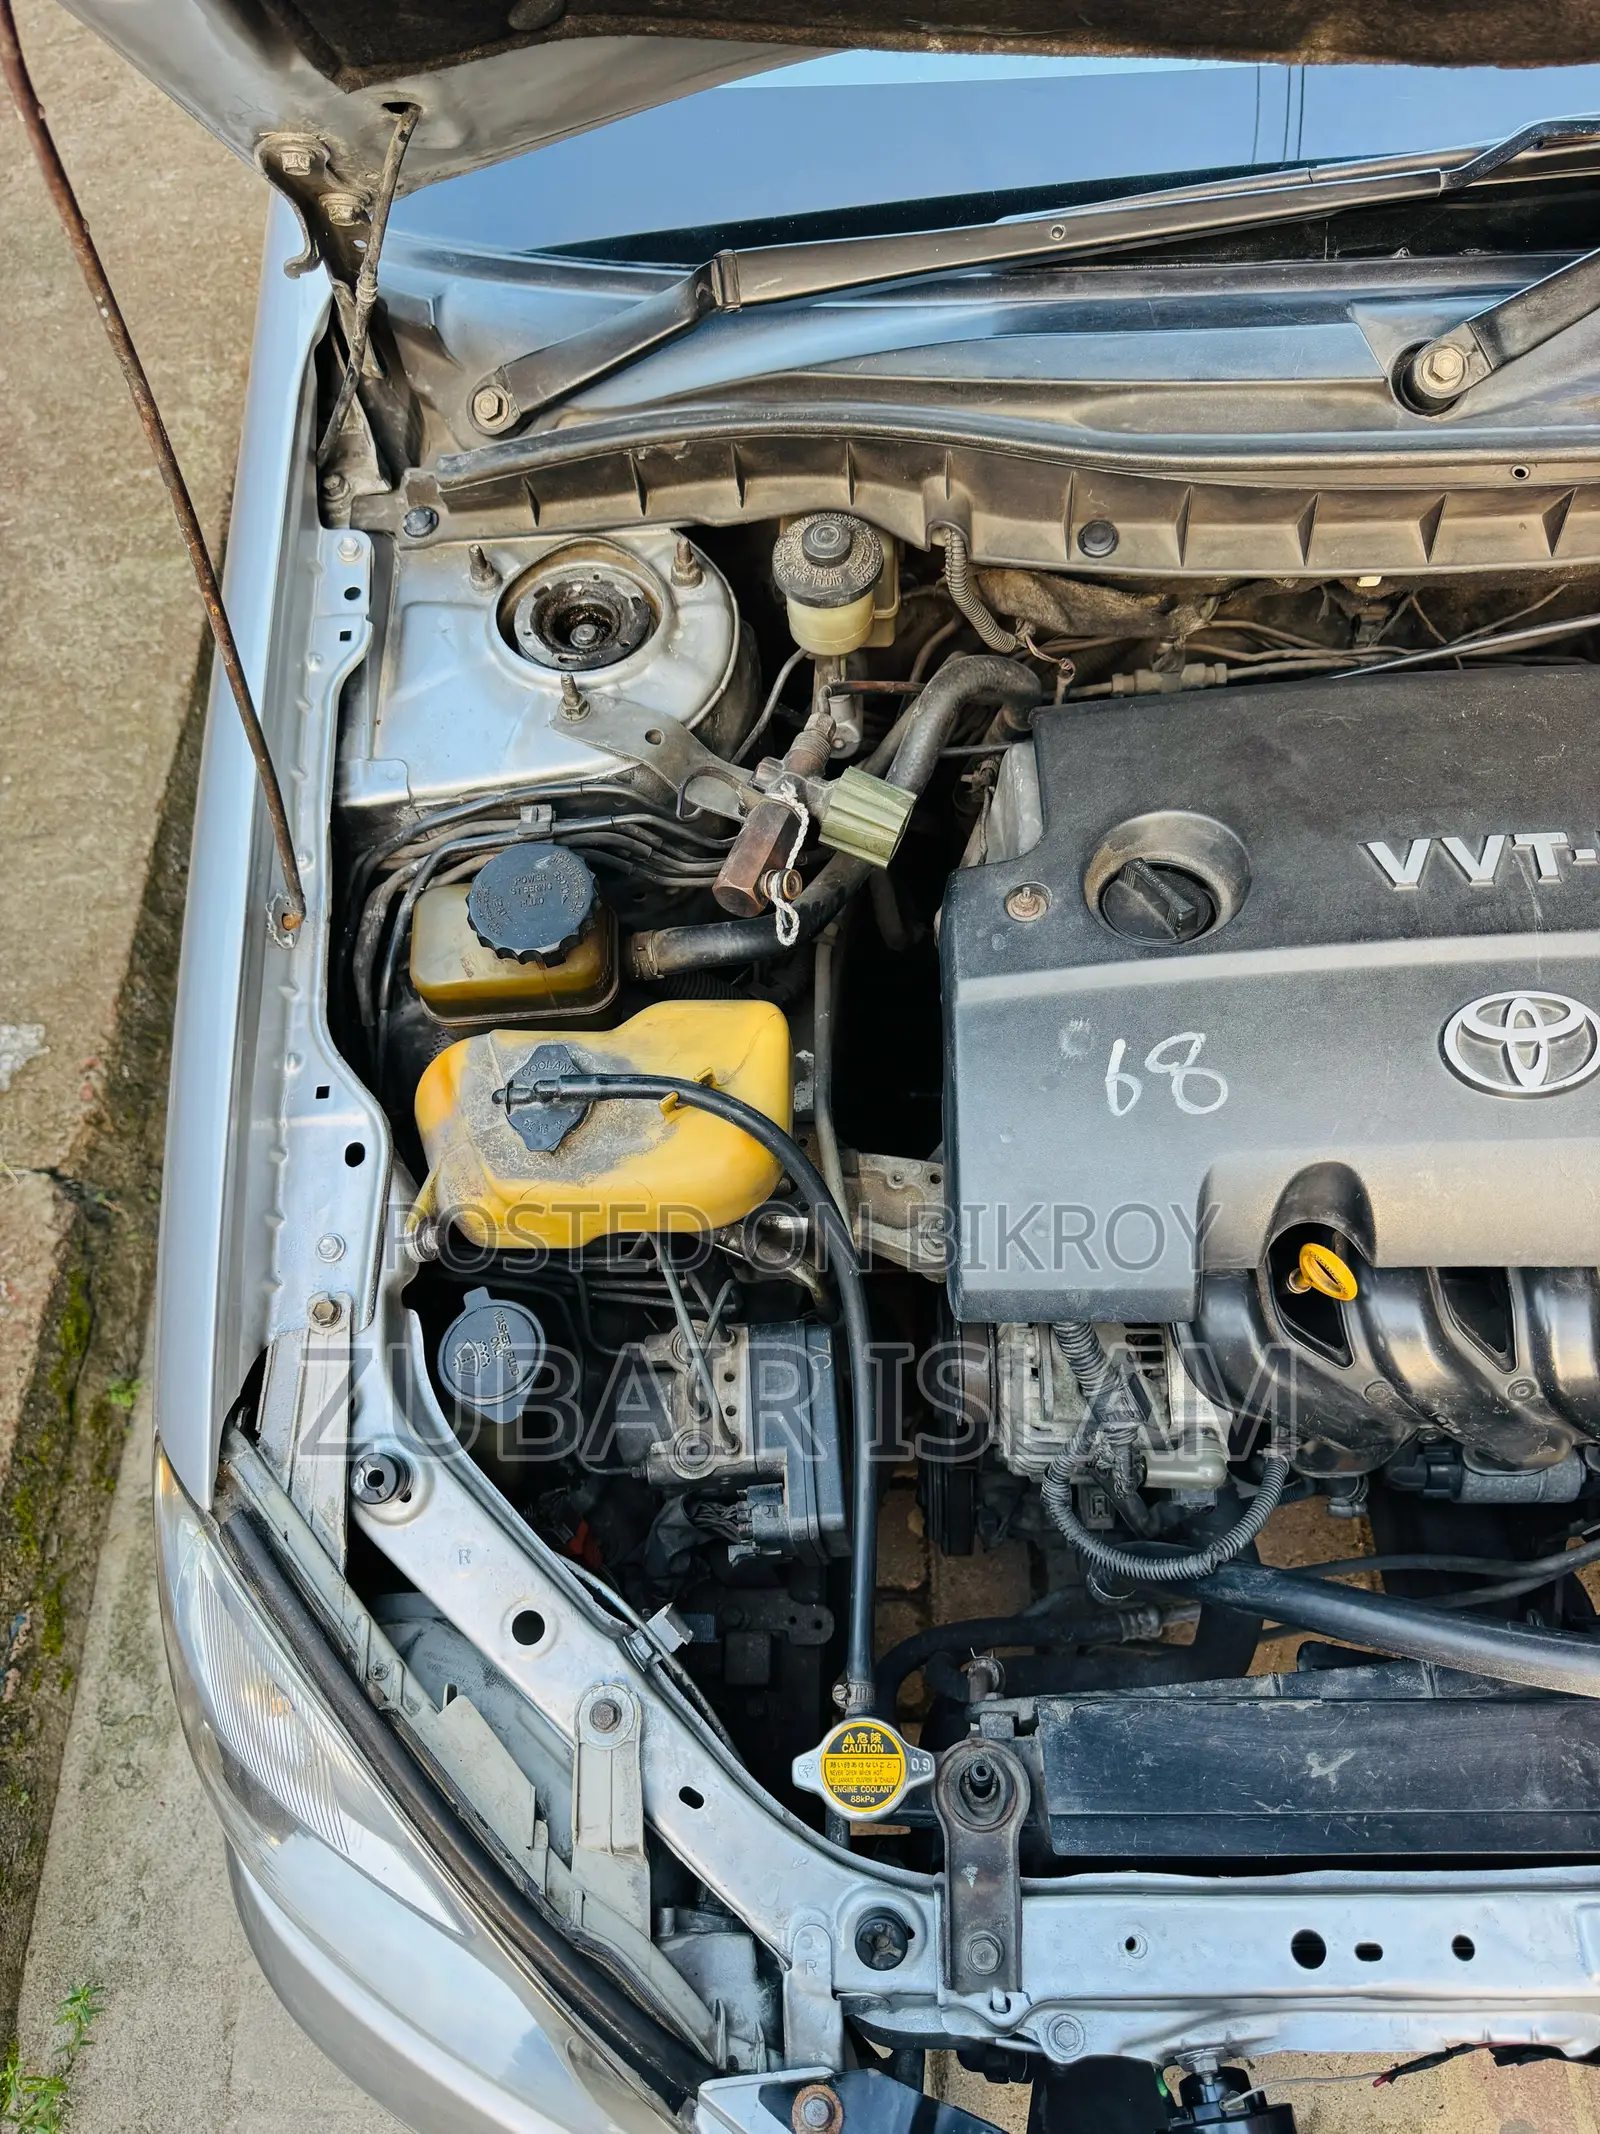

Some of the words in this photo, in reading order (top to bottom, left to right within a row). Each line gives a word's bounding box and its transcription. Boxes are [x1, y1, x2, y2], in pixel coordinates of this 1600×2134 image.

[804, 566, 841, 577] BEFORE
[1360, 832, 1600, 889] VVT-
[514, 874, 548, 886] POWER
[510, 882, 553, 895] STEERING
[521, 1060, 578, 1078] COOLANT
[1104, 1030, 1229, 1117] 68
[489, 1336, 504, 1358] ONLY
[493, 1310, 513, 1350] WASHER
[504, 1350, 520, 1377] FLUID
[458, 1548, 472, 1565] R
[857, 1732, 882, 1744] 危険
[841, 1743, 884, 1753] CAUTION
[910, 1757, 931, 1771] 0.9
[833, 1785, 858, 1793] ENGINE
[860, 1785, 893, 1793] COOLANT
[850, 1795, 876, 1804] 88kPa
[805, 1959, 818, 1976] R
